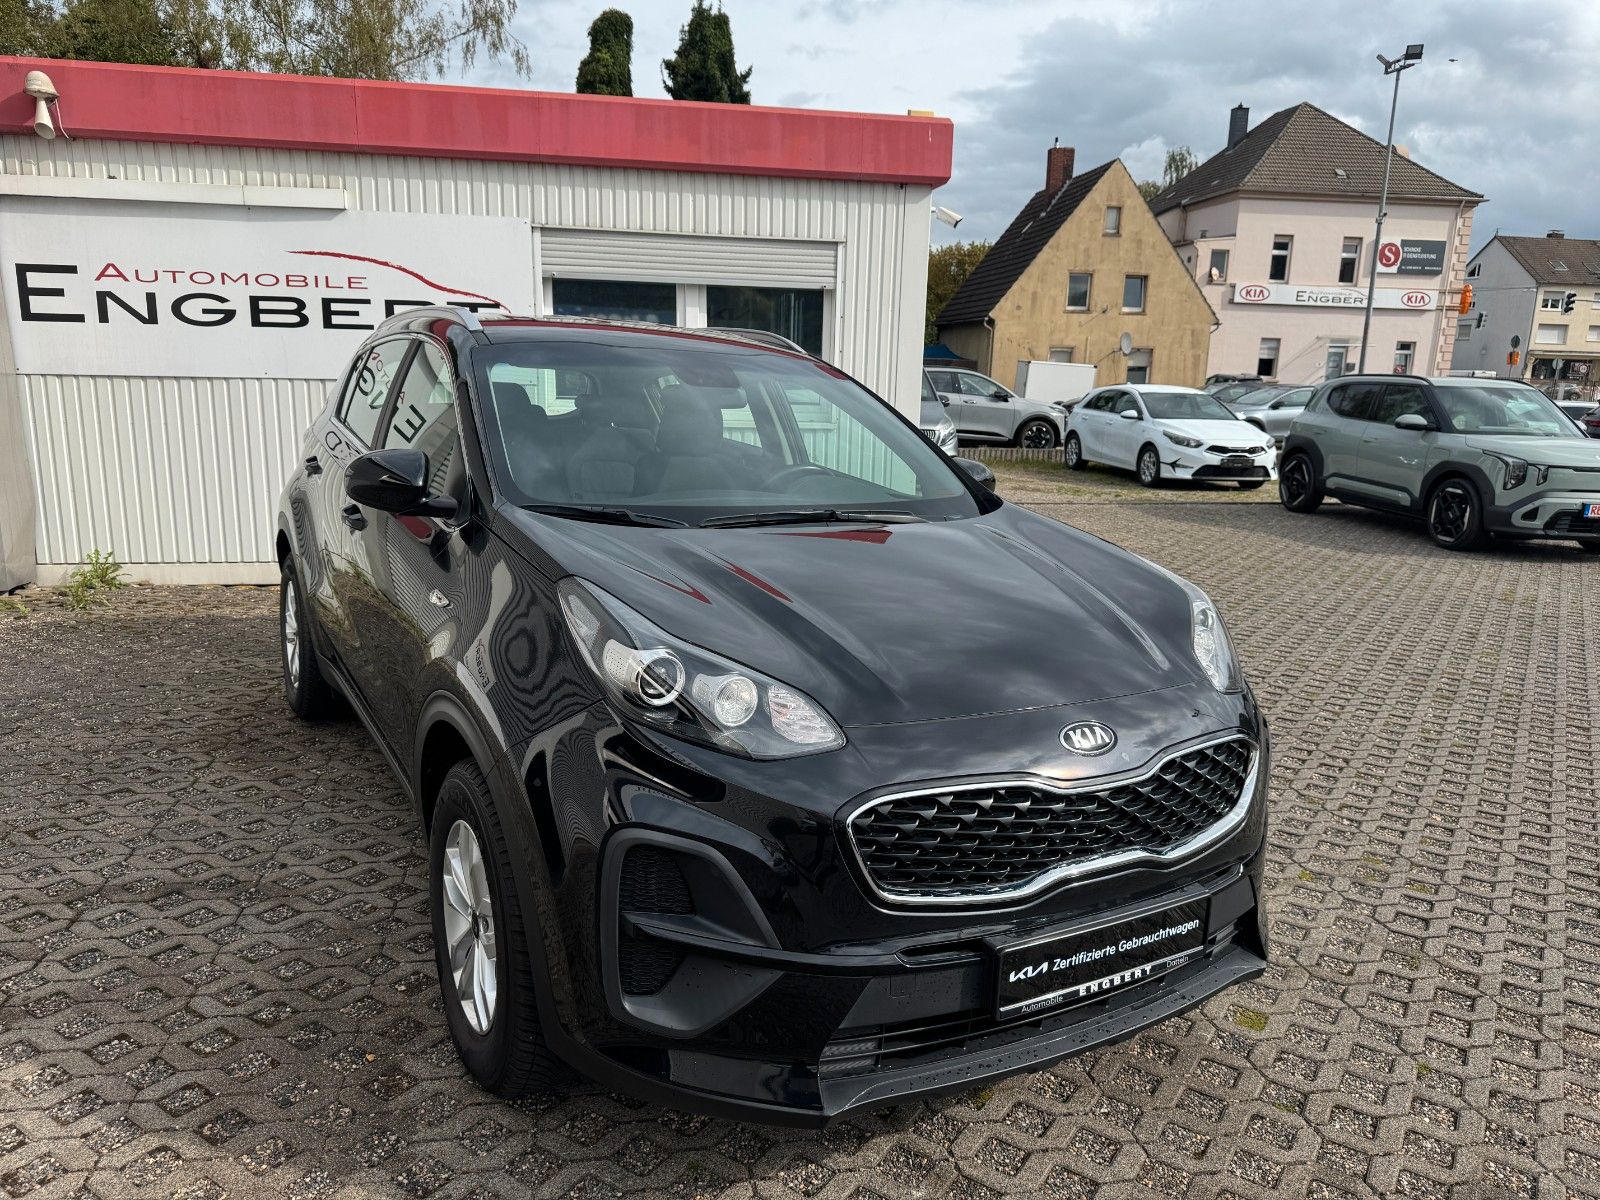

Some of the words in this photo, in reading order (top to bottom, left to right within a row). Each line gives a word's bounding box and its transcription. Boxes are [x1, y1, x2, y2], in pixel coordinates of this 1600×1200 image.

[1382, 246, 1396, 265] S
[95, 263, 368, 290] AUTOMOBILE
[1066, 726, 1110, 749] KIA
[1009, 961, 1049, 983] KIA
[1052, 944, 1116, 971] Zertifizierte
[1118, 919, 1199, 952] Gebrauchtwagen
[1021, 995, 1064, 1013] Automobile
[1079, 965, 1152, 997] ENGBERT
